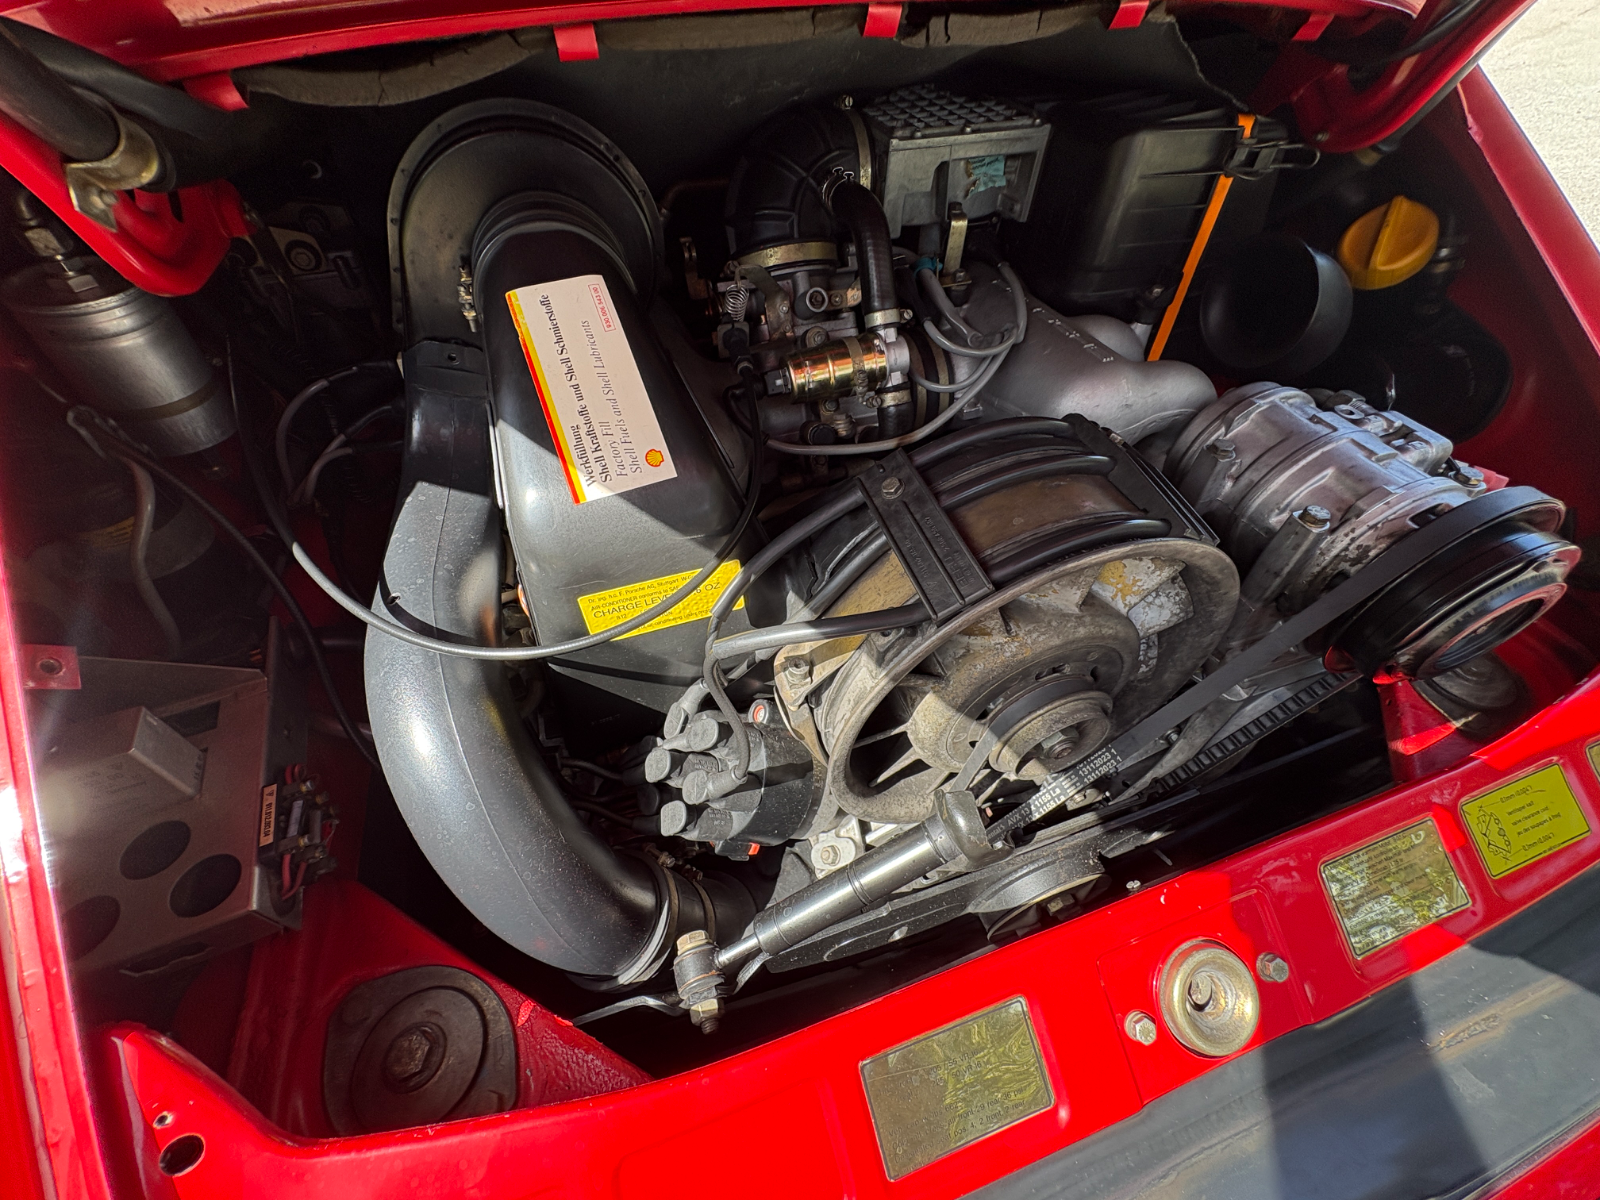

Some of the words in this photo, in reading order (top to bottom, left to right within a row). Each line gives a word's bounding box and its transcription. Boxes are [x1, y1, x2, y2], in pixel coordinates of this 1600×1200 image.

[539, 294, 567, 355] Schmierstoffe
[581, 320, 604, 368] Lubricants
[559, 357, 576, 381] Shell
[569, 383, 584, 401] und
[596, 372, 614, 395] Shell
[605, 398, 622, 416] and
[577, 404, 601, 453] Kraftstoffe
[598, 421, 614, 436] Fill
[614, 418, 632, 443] Fuels
[570, 424, 596, 486] Werkfüllung
[608, 439, 628, 476] Factory
[623, 447, 642, 473] Shell
[593, 455, 611, 482] Shell
[593, 600, 642, 618] CHARGE
[703, 581, 720, 591] OZ
[624, 586, 645, 595] Porsche
[1079, 752, 1111, 776] 13112023
[1083, 759, 1116, 783] 13112023
[1007, 812, 1021, 826] AVX
[1020, 807, 1030, 815] 13
[1034, 792, 1051, 806] 1155
[1049, 787, 1061, 796] La
[1039, 800, 1056, 814] 1155
[1521, 810, 1540, 821] clearance
